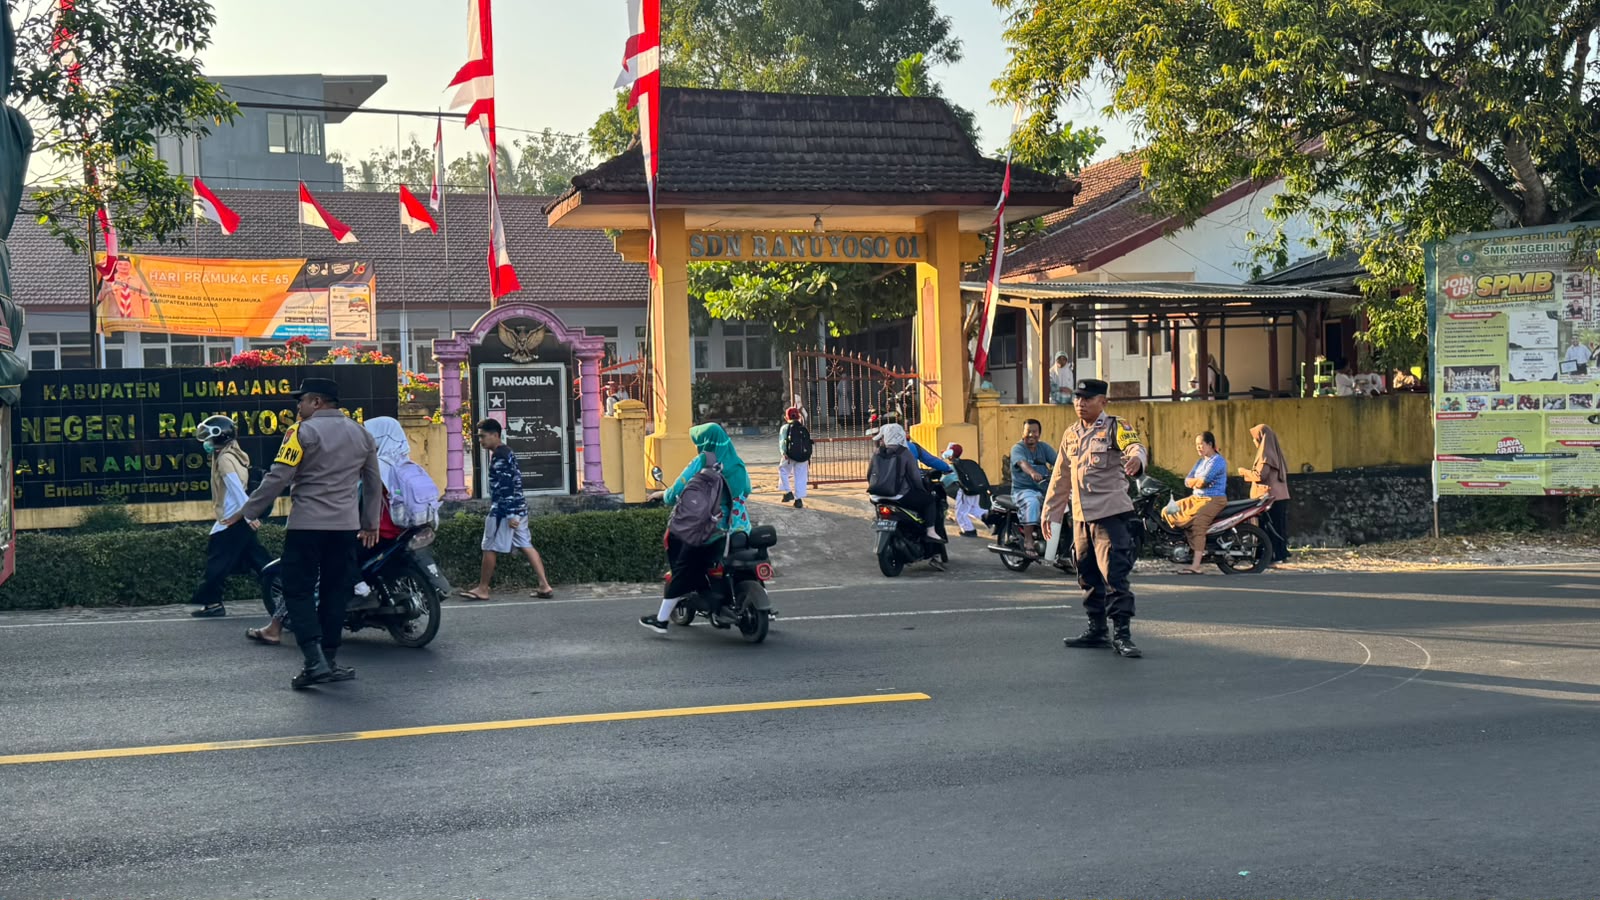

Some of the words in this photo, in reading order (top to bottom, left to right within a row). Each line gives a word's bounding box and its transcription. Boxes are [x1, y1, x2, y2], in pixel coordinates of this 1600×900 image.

[689, 234, 742, 258] SDN
[752, 234, 890, 258] RANUYOSO
[896, 235, 920, 258] 01
[1483, 245, 1507, 255] SMK
[1511, 243, 1554, 253] NEGERI
[149, 271, 180, 283] HARI
[184, 272, 248, 284] PRAMUKA
[251, 273, 289, 285] KE-65
[1442, 275, 1473, 290] JOIN
[1476, 271, 1555, 298] SPMB
[1452, 284, 1474, 297] US!
[492, 376, 554, 386] PANCASILA
[43, 382, 160, 400] KABUPATEN
[183, 379, 291, 397] LUMAJANG
[21, 414, 136, 442] NEGERI
[1497, 438, 1520, 448] BIAYA
[283, 447, 299, 462] RW
